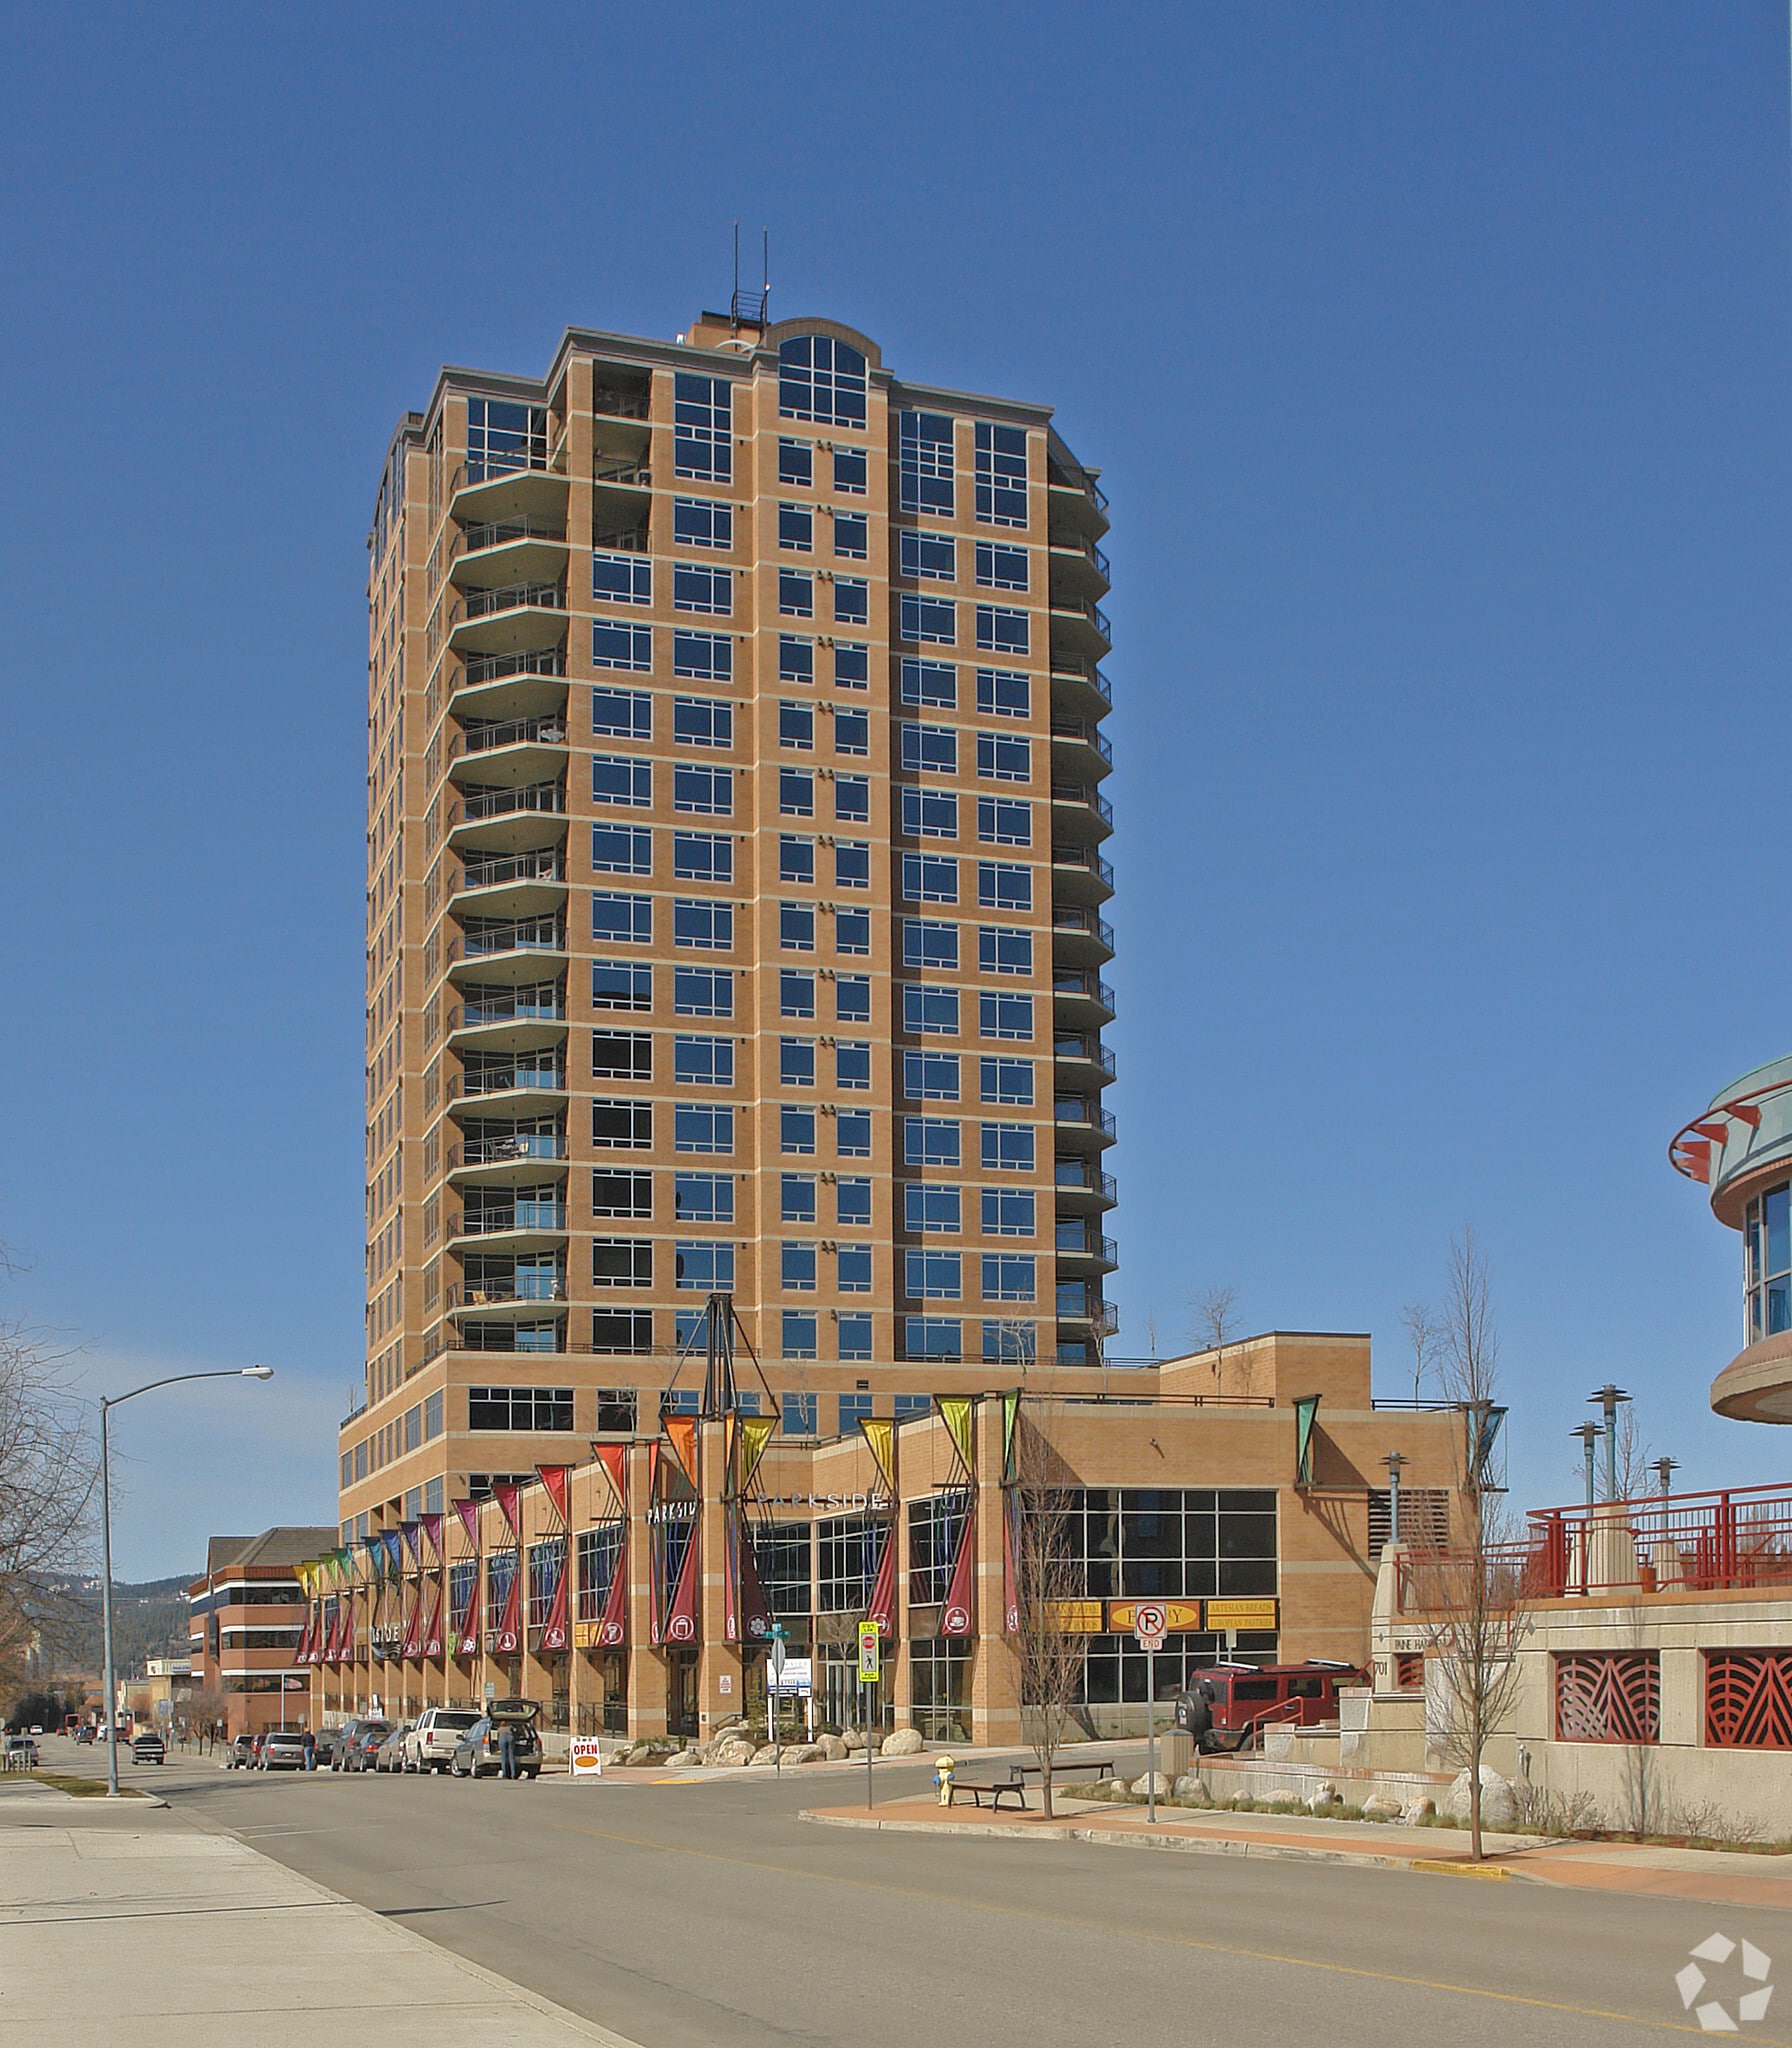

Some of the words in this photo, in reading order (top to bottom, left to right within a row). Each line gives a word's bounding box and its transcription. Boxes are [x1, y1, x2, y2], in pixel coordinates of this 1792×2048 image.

[757, 1491, 888, 1510] PARKSIDE
[1142, 1640, 1160, 1648] END
[1375, 1661, 1388, 1676] 701
[573, 1744, 598, 1755] OPEN
